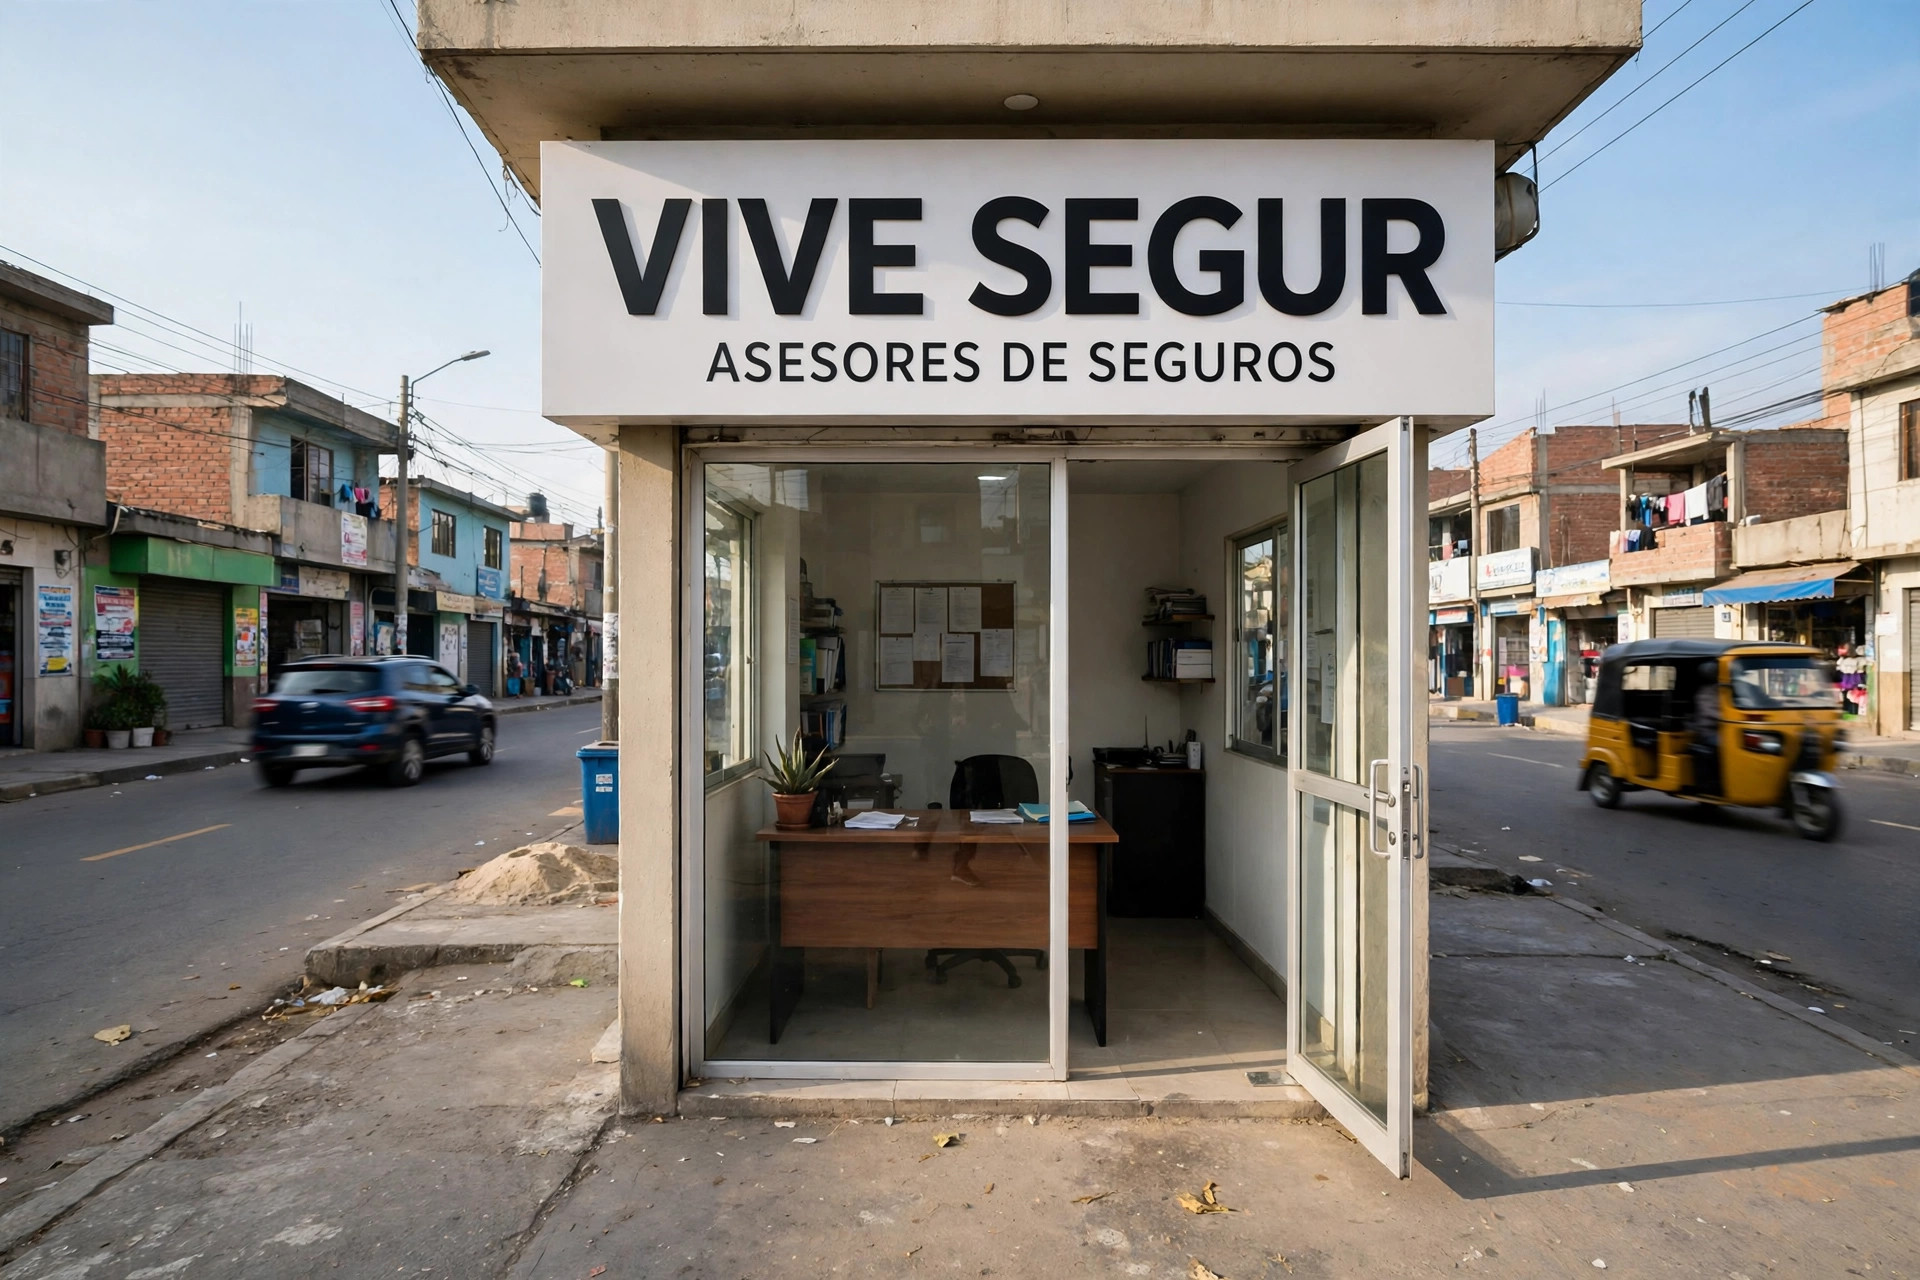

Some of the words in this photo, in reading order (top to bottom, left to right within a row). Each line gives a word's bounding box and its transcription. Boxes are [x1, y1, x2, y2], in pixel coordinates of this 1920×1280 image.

[592, 198, 924, 316] VIVE
[968, 196, 1448, 317] SEGUR
[706, 341, 980, 383] ASESORES
[1003, 342, 1068, 382] DE
[1088, 341, 1335, 383] SEGUROS
